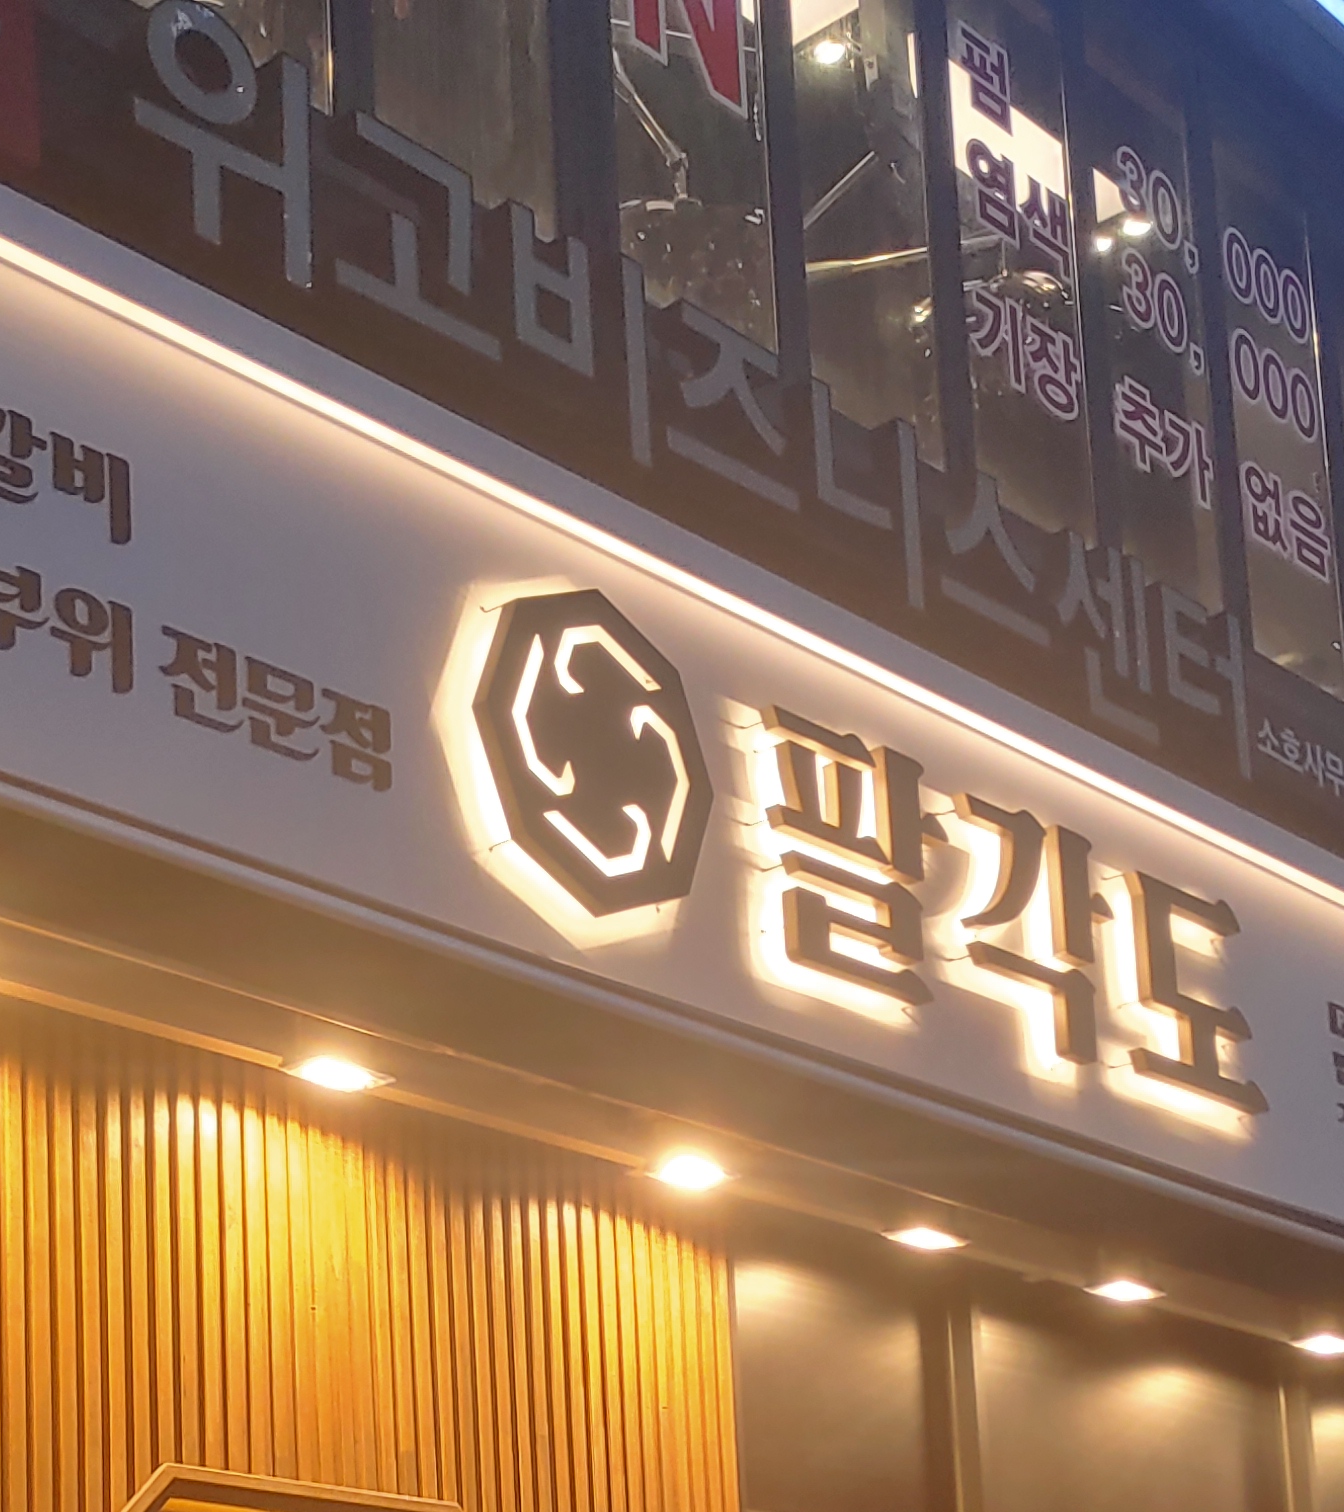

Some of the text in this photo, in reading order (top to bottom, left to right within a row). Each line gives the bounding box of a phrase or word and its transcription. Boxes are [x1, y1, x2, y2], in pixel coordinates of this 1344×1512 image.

[959, 22, 1013, 134] 펌
[965, 139, 1072, 288] 염색
[968, 287, 1330, 582] 기장 추가 없음
[159, 625, 394, 792] 전문점
[760, 705, 1270, 1114] 팔각도
